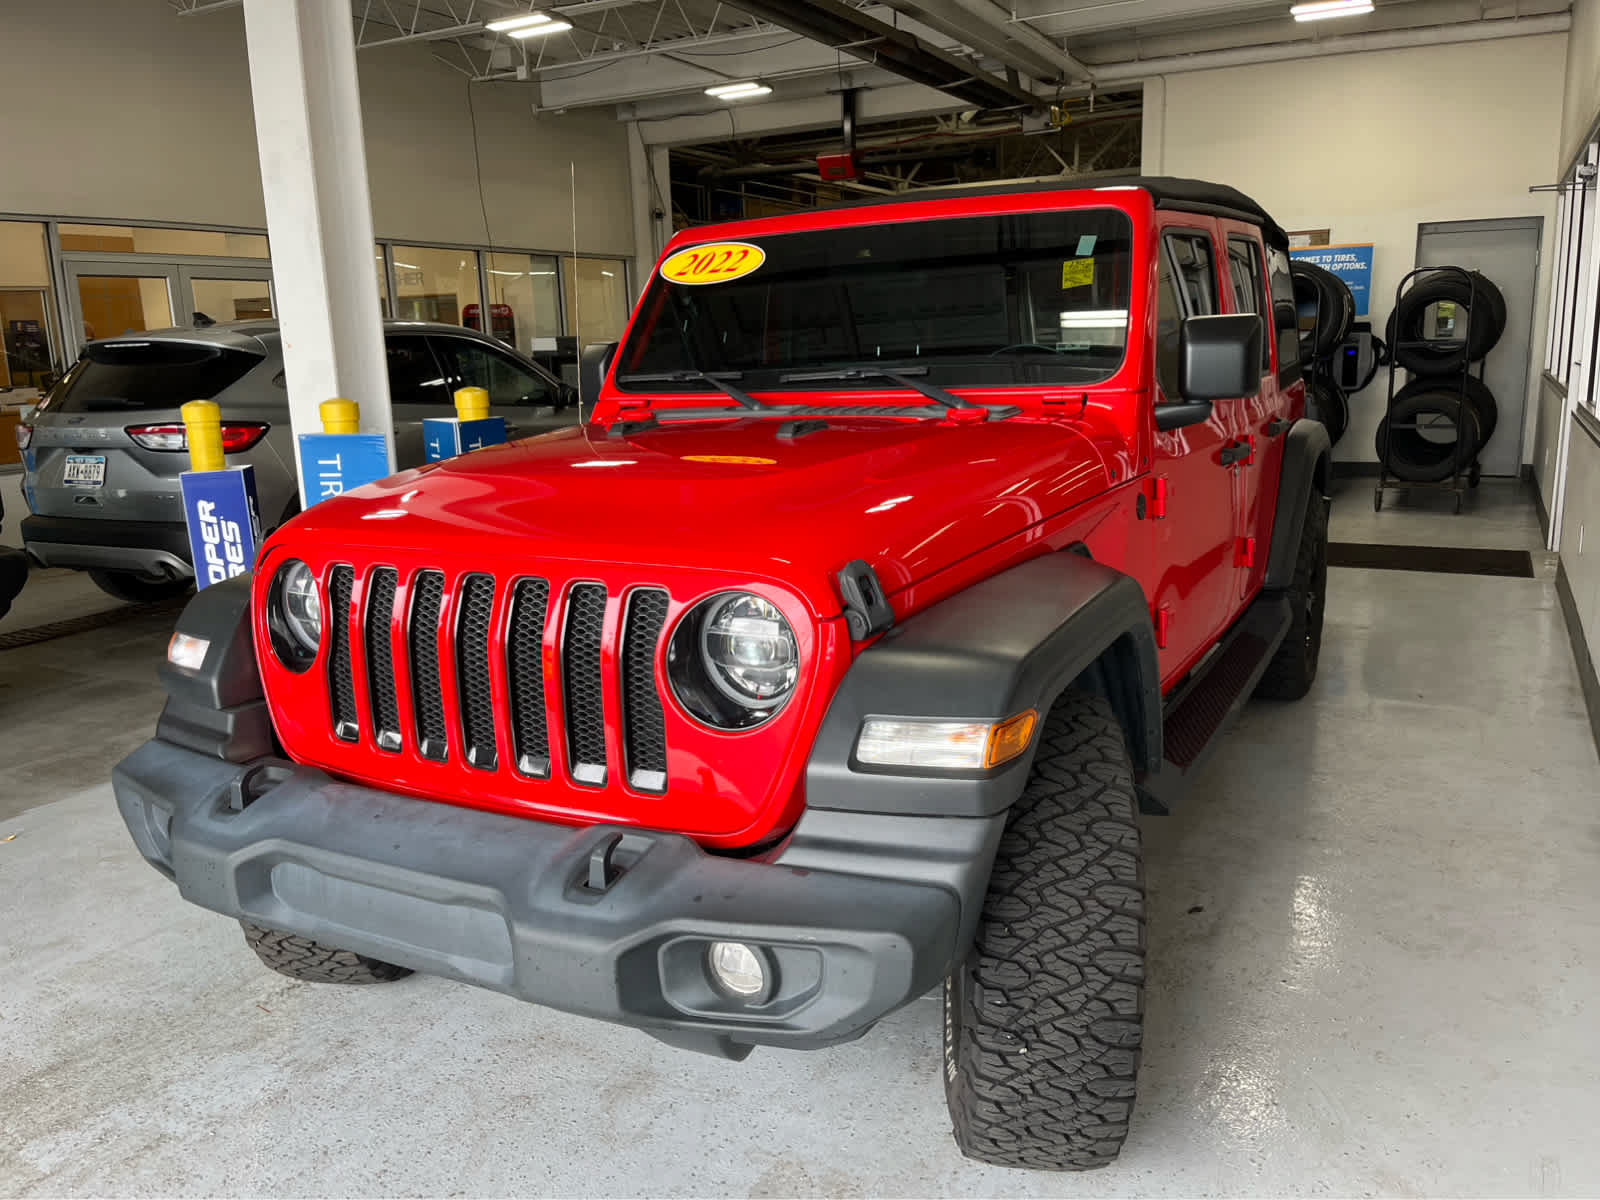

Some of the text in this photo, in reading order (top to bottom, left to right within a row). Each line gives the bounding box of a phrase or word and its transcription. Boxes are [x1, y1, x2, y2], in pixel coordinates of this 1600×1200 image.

[674, 249, 749, 276] 2022
[1334, 254, 1358, 262] TIRES,
[1331, 262, 1368, 271] OPTIONS.
